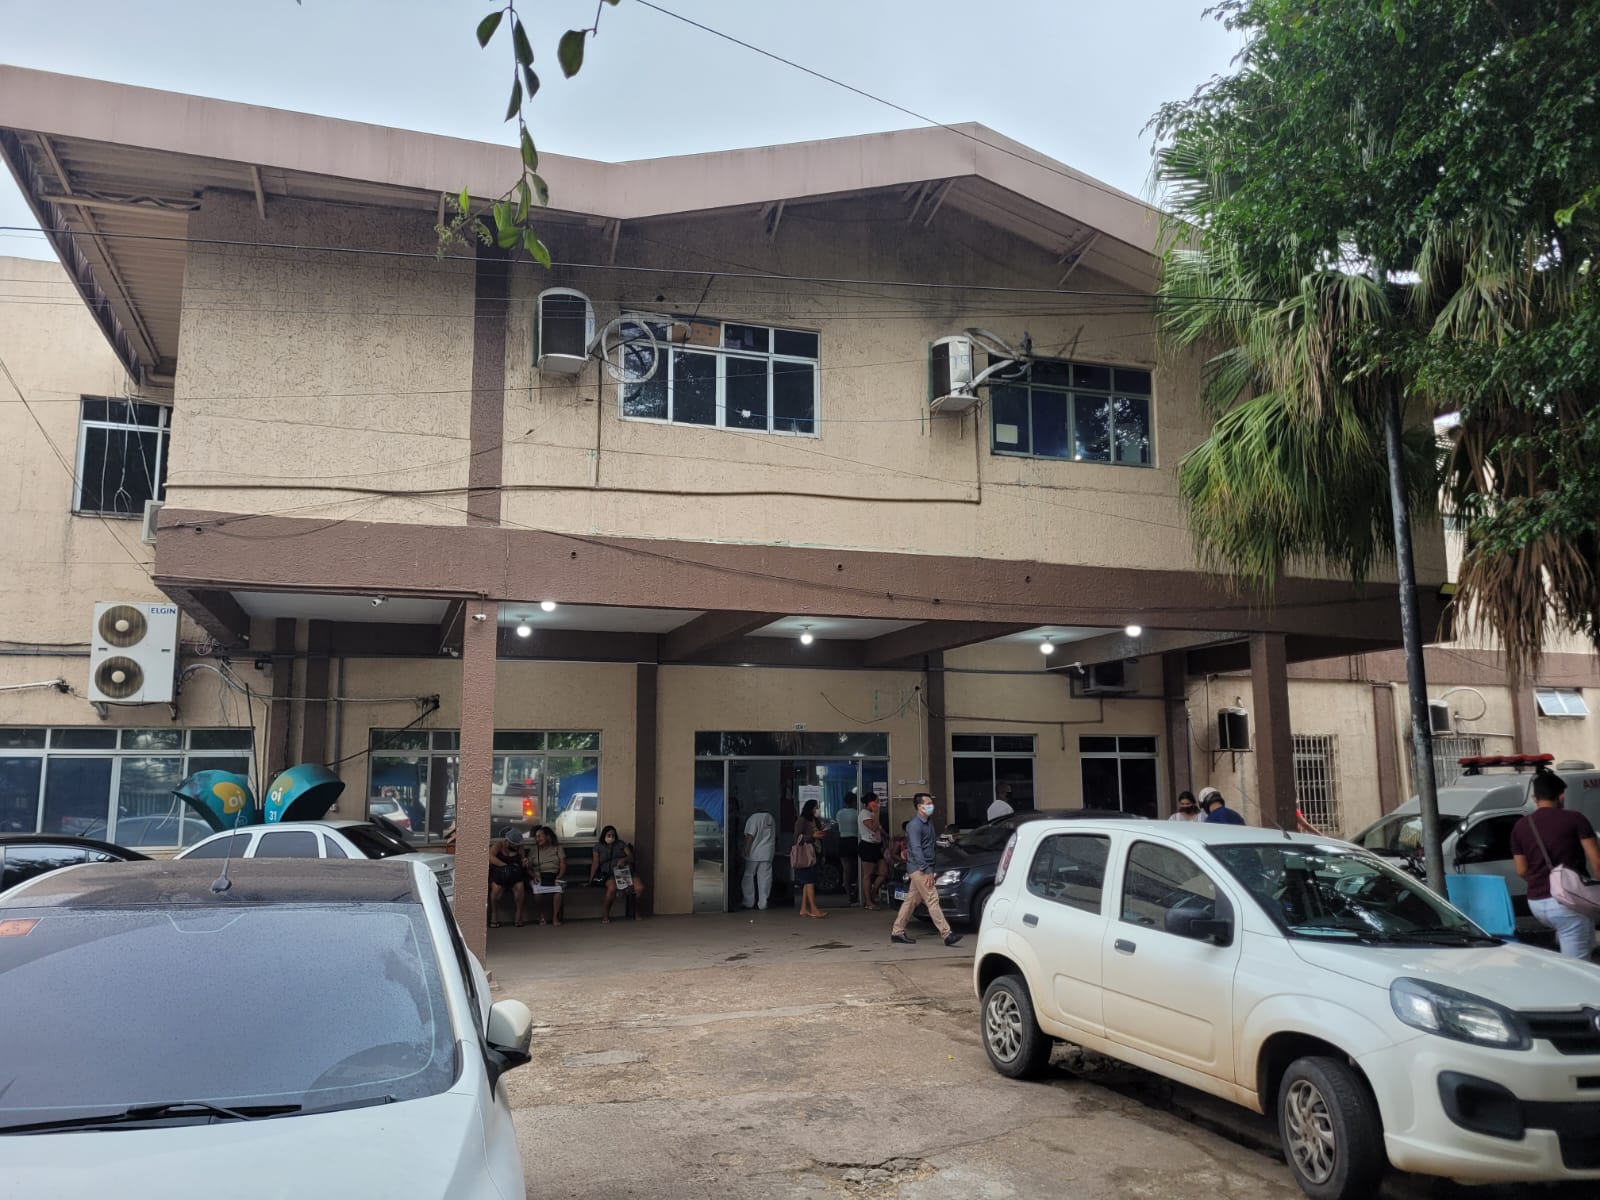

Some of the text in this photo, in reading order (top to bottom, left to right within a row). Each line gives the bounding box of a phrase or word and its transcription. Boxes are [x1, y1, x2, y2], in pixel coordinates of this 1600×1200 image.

[151, 607, 176, 615] ELGIN
[228, 790, 243, 807] oi
[271, 787, 283, 803] oi
[268, 810, 277, 821] 31
